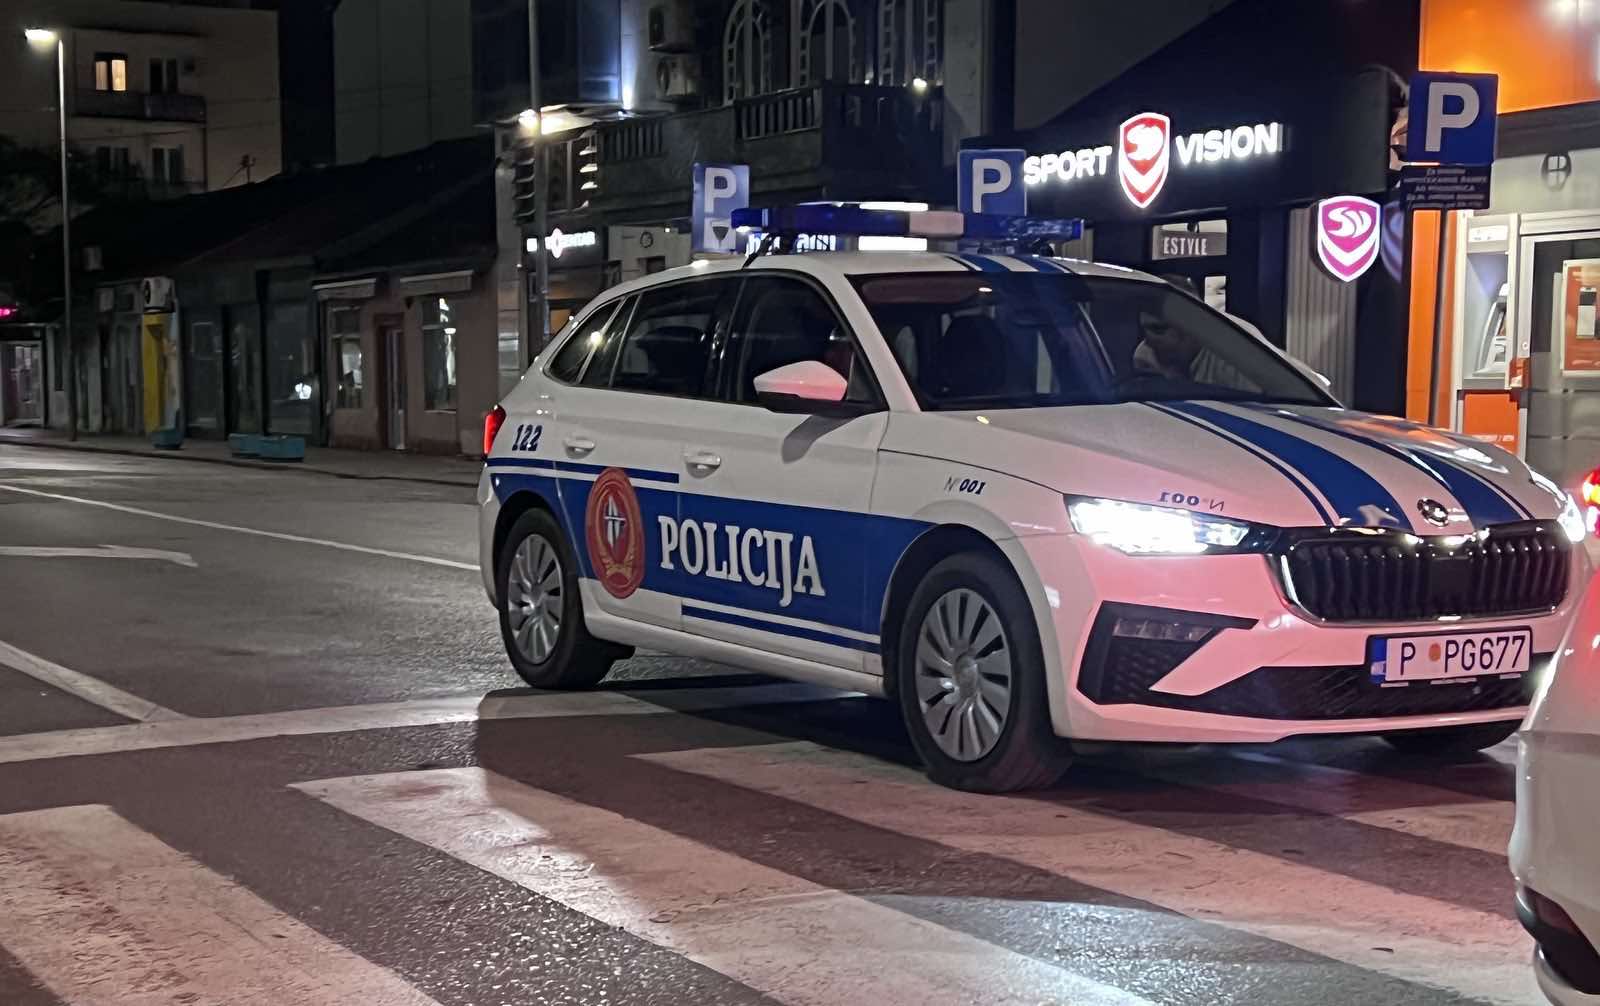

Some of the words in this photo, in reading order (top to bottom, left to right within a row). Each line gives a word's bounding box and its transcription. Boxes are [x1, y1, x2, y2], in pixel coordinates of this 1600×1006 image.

[1425, 82, 1479, 152] P
[1023, 146, 1112, 185] SPORT
[1175, 122, 1279, 166] VISION
[704, 167, 737, 213] P
[972, 159, 1012, 213] P
[1163, 236, 1208, 256] ESTYLE
[511, 424, 543, 452] 122
[657, 515, 826, 607] POLICIJA
[1401, 642, 1416, 676] P
[1445, 635, 1526, 673] PG677
